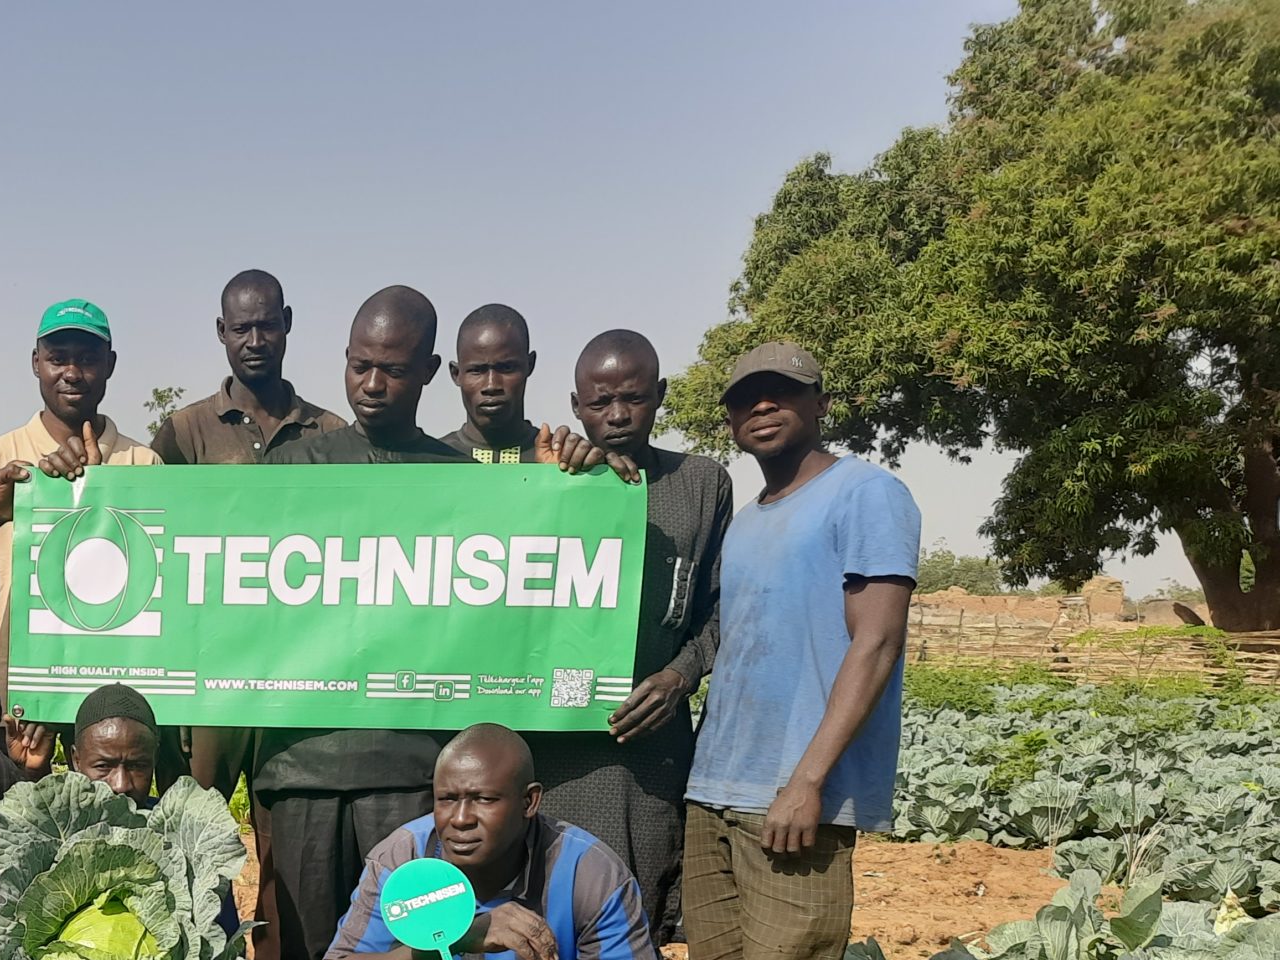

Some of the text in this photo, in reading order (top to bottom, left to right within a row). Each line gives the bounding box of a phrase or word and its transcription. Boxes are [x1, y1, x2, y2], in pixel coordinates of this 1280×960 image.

[173, 533, 623, 608] TECHNISEM
[50, 665, 165, 677] HIGH QUALITY INSIDE
[204, 679, 358, 691] WWW.TECHNISEM.COM
[476, 685, 542, 698] Download our app
[404, 882, 466, 911] TECHNISEM
